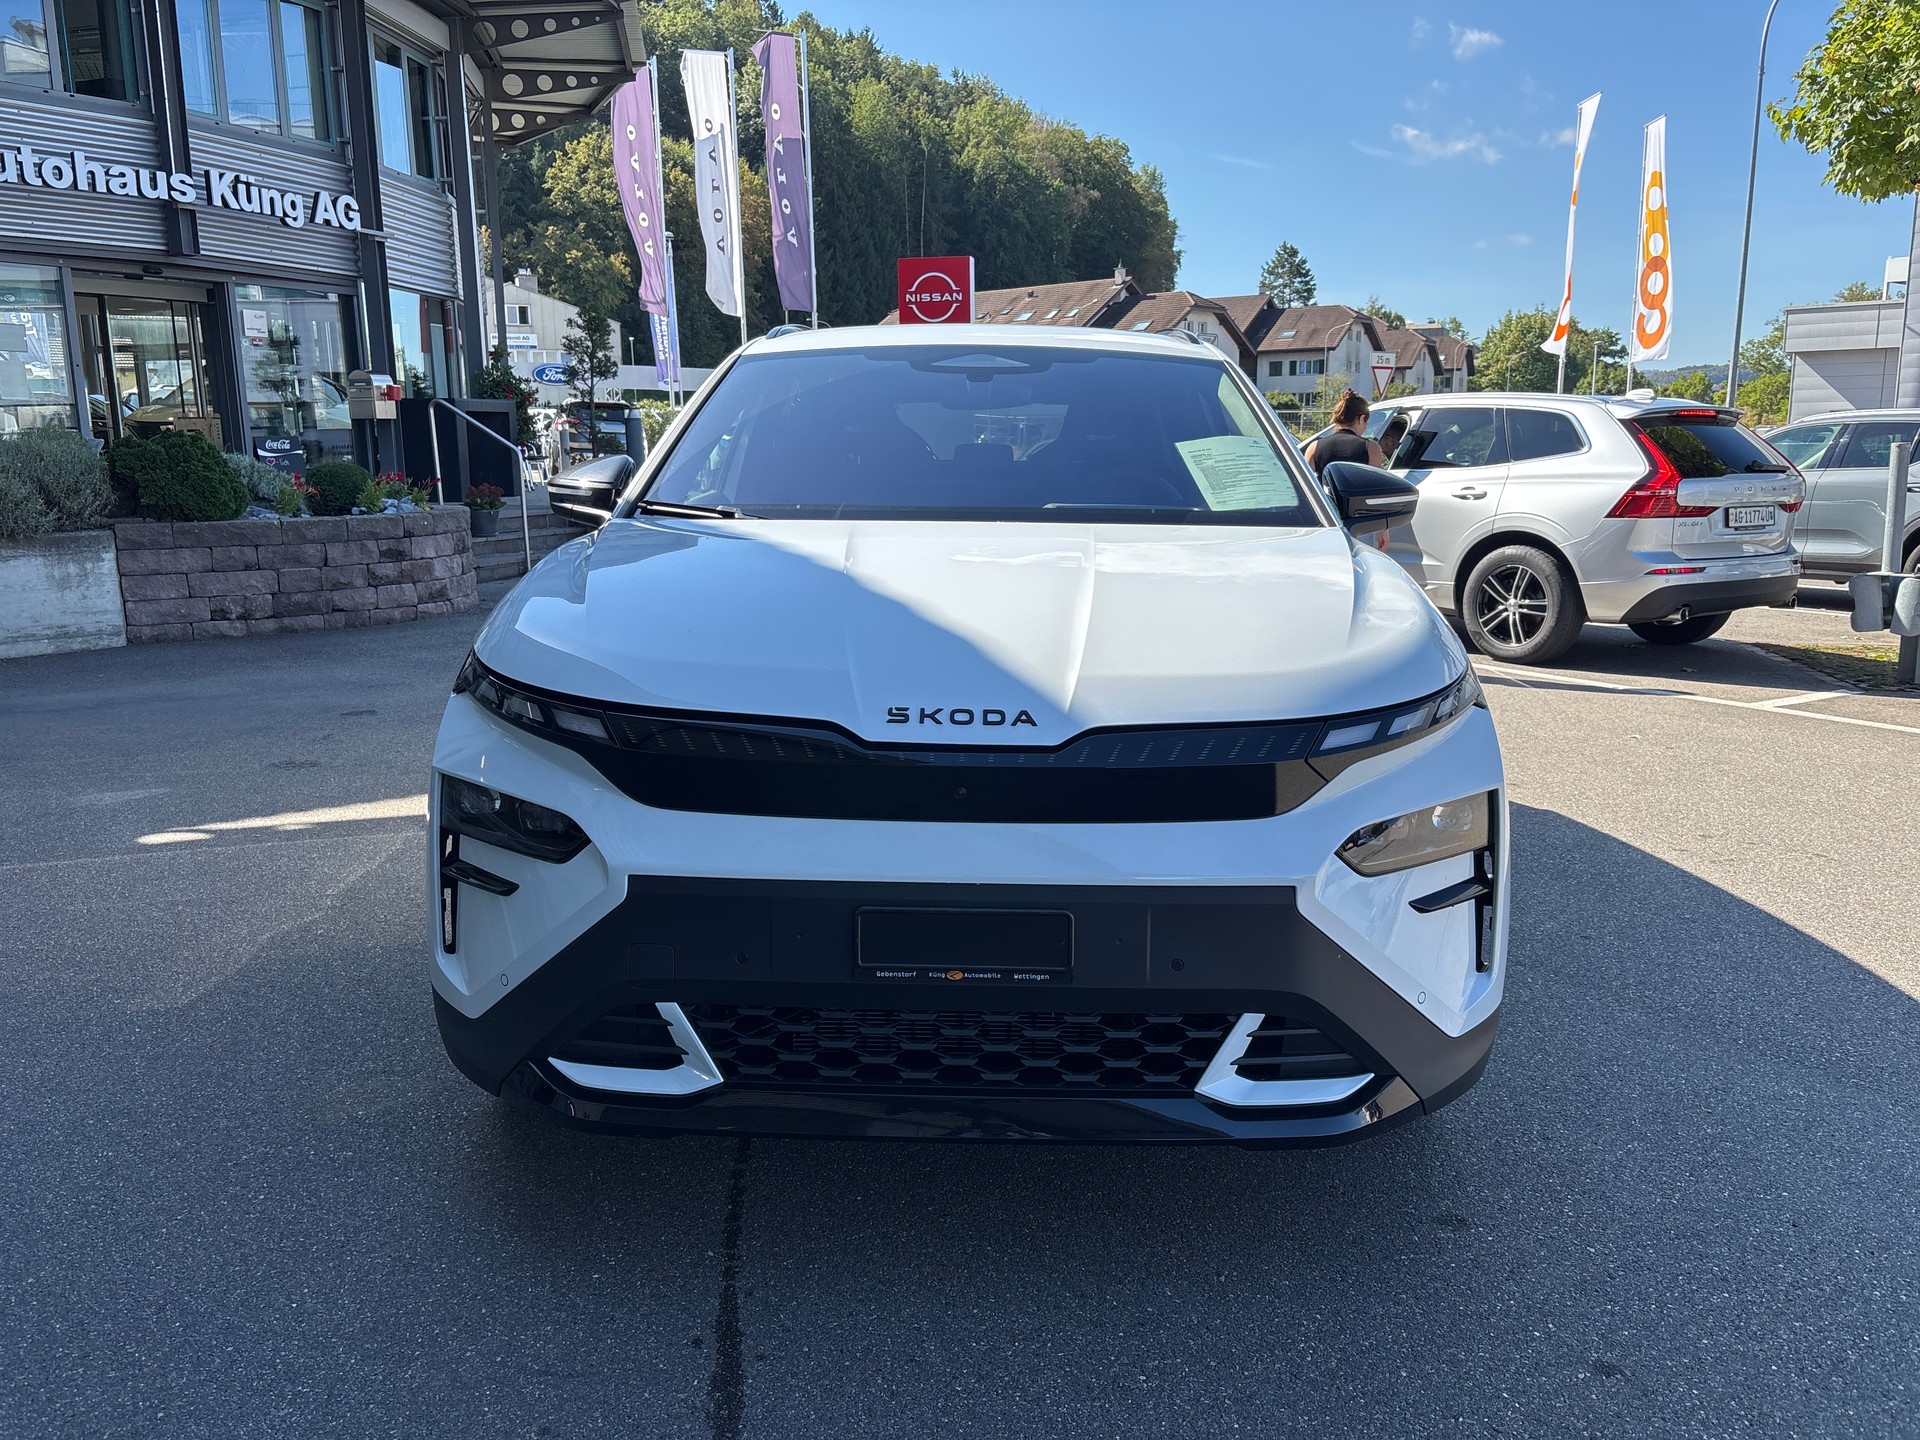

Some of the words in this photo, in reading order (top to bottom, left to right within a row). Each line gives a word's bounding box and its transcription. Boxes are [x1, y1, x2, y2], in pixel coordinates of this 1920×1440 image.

[205, 169, 304, 228] Küng
[312, 190, 361, 230] AG
[905, 292, 963, 303] NISSAN
[1377, 355, 1384, 364] 25
[876, 970, 917, 978] Gebenstorf
[929, 971, 946, 979] Küng
[964, 972, 1002, 980] Automobile
[1013, 973, 1050, 981] Wettingen
